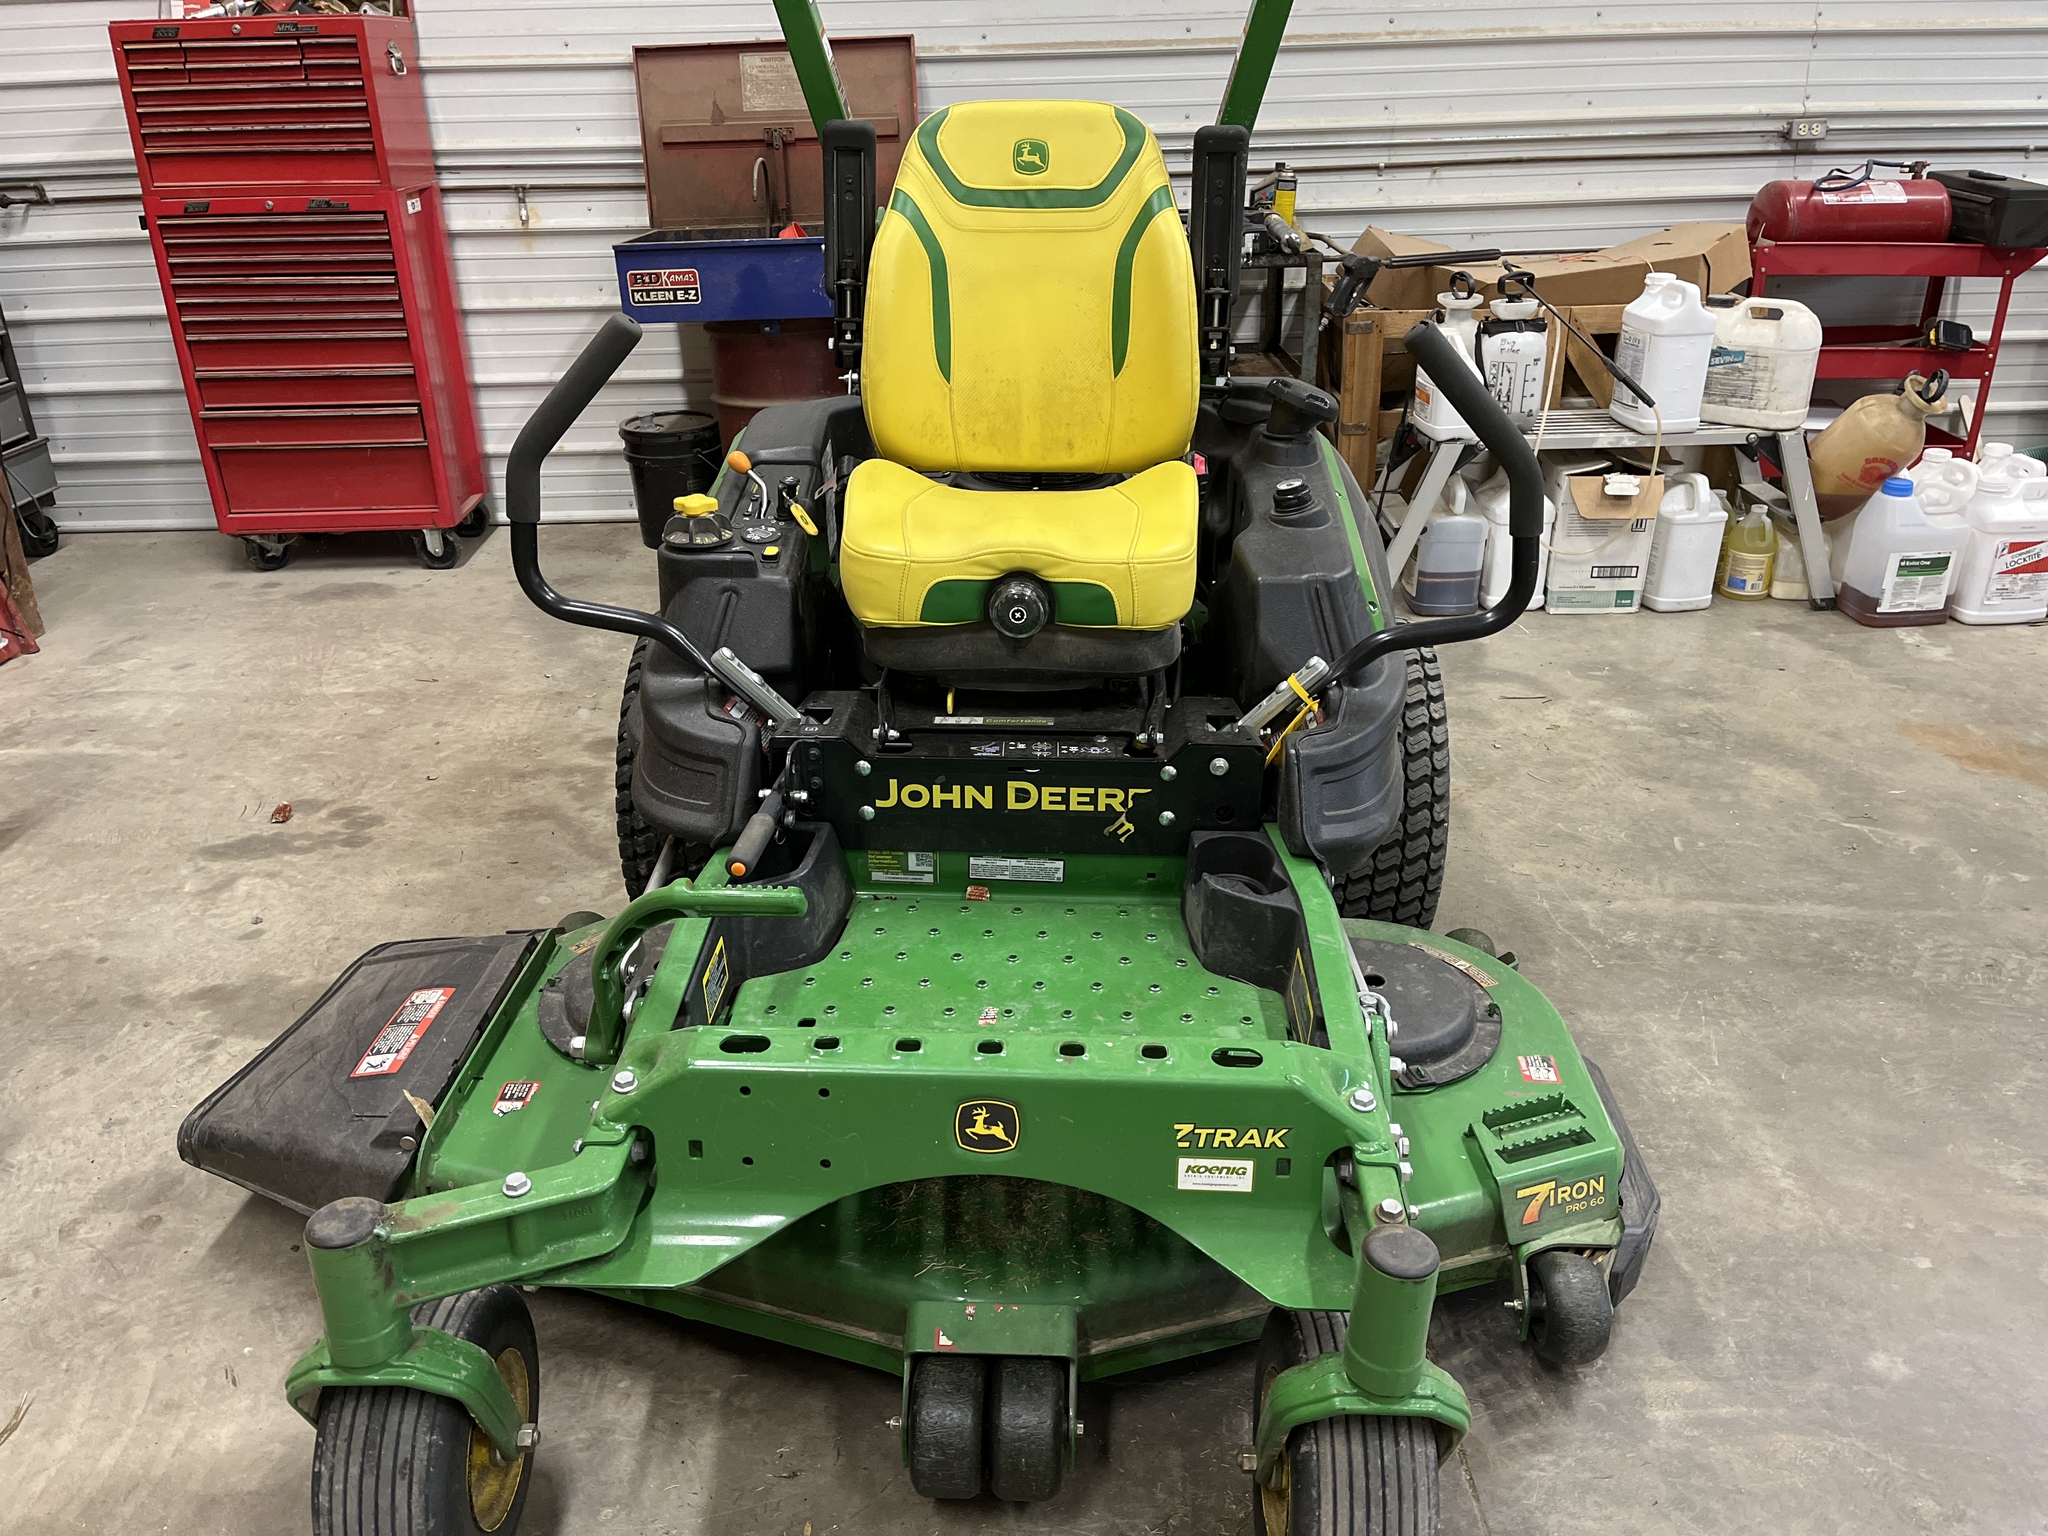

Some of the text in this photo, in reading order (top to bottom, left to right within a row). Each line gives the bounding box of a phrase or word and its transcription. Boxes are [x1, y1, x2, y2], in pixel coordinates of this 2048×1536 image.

[633, 290, 698, 302] KLEEN E-Z
[1500, 338, 1516, 347] Bug
[1710, 354, 1735, 365] SEVIN
[2005, 551, 2042, 569] LOCKTITE
[875, 778, 993, 810] JOHN
[1174, 1123, 1291, 1149] ZTRAK
[1565, 1196, 1606, 1214] PRO 60
